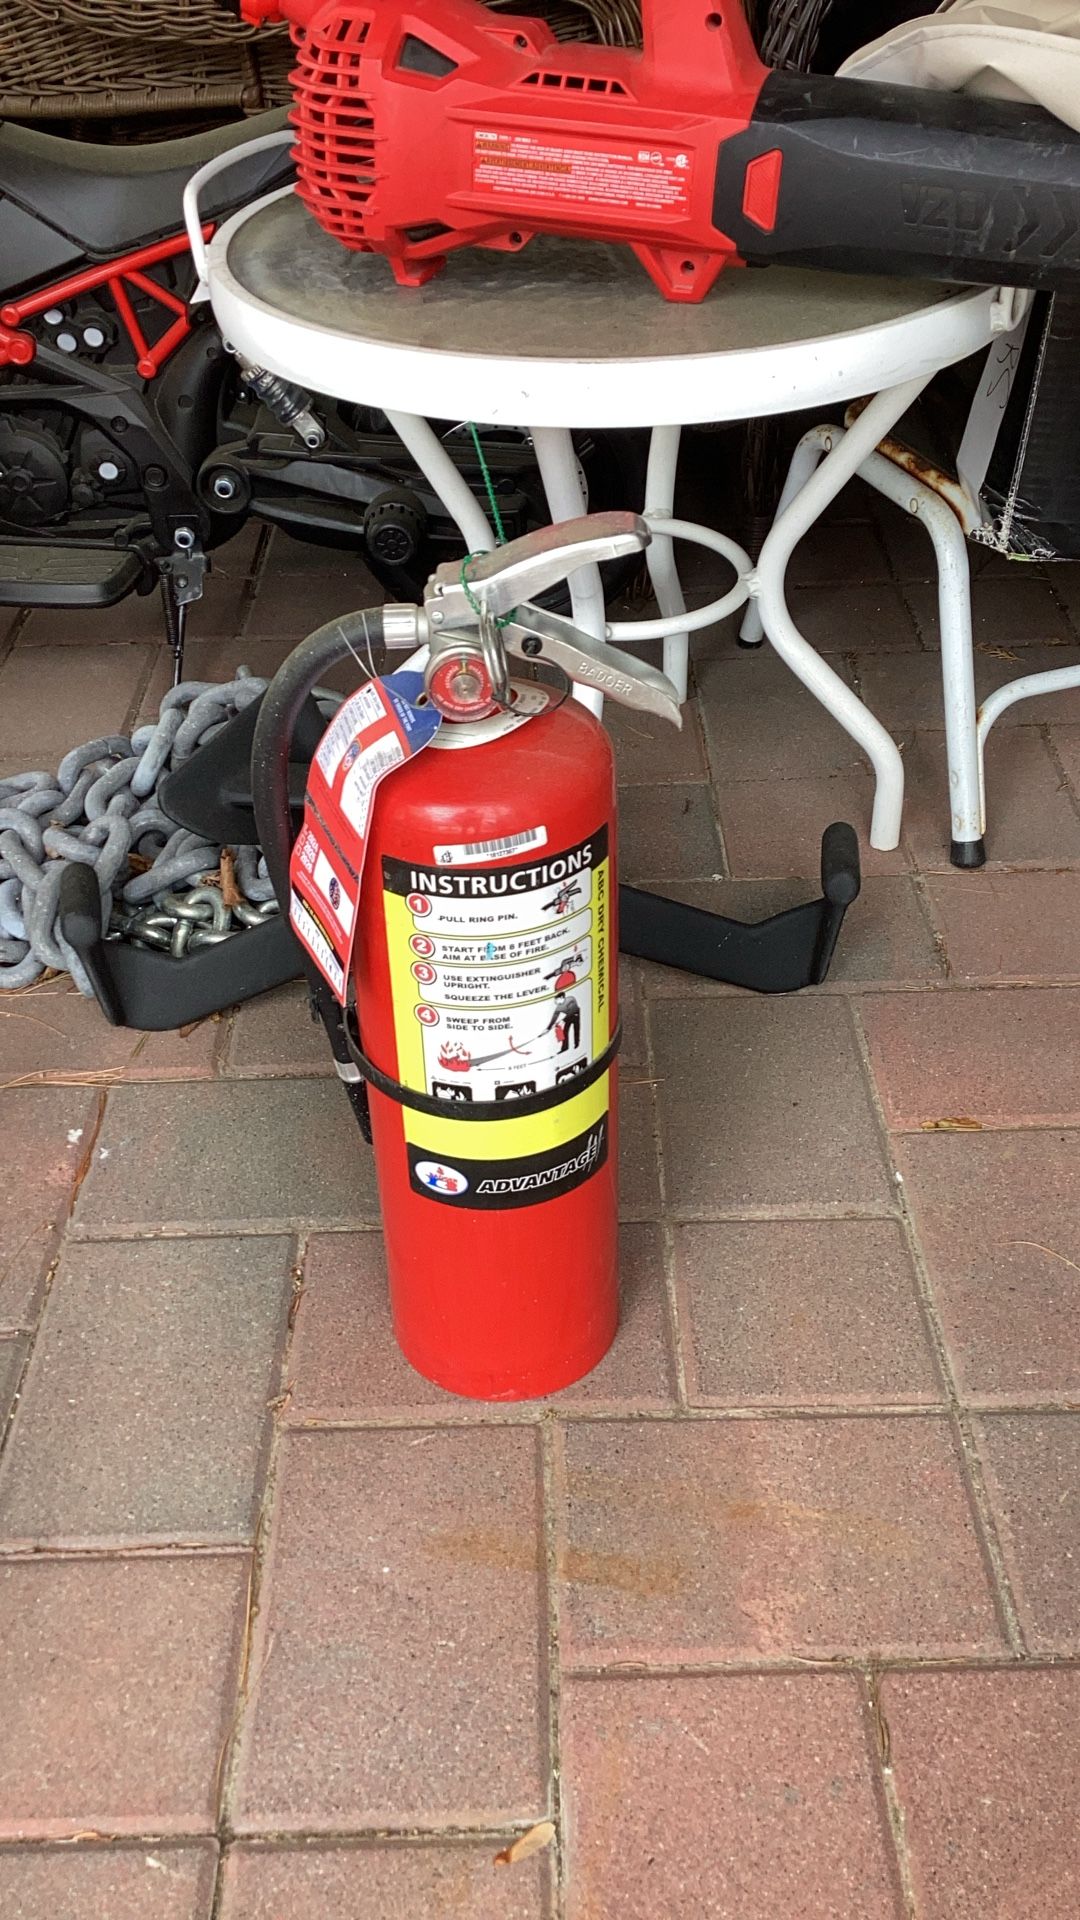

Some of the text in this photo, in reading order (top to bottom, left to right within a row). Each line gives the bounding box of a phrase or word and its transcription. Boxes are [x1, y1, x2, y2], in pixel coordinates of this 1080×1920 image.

[579, 662, 633, 696] BADGER
[410, 844, 593, 895] INSTRUCTIONS
[440, 914, 518, 923] PULL RING PIN.
[442, 945, 474, 953] START
[518, 939, 542, 949] FEET
[545, 928, 570, 942] BACK.
[597, 870, 605, 1013] ABC DRY CHEMICAL
[464, 954, 476, 962] AT
[509, 950, 522, 960] OF
[525, 944, 550, 955] FIRE.
[443, 967, 541, 983] USE EXTINGUISHER
[443, 981, 491, 990] UPRIGHT.
[444, 985, 550, 1002] SQUEEZE THE LEVER.
[446, 1016, 511, 1024] SWEEP FROM
[487, 1023, 514, 1031] SIDE.
[476, 1144, 597, 1194] ADVANTAGE
